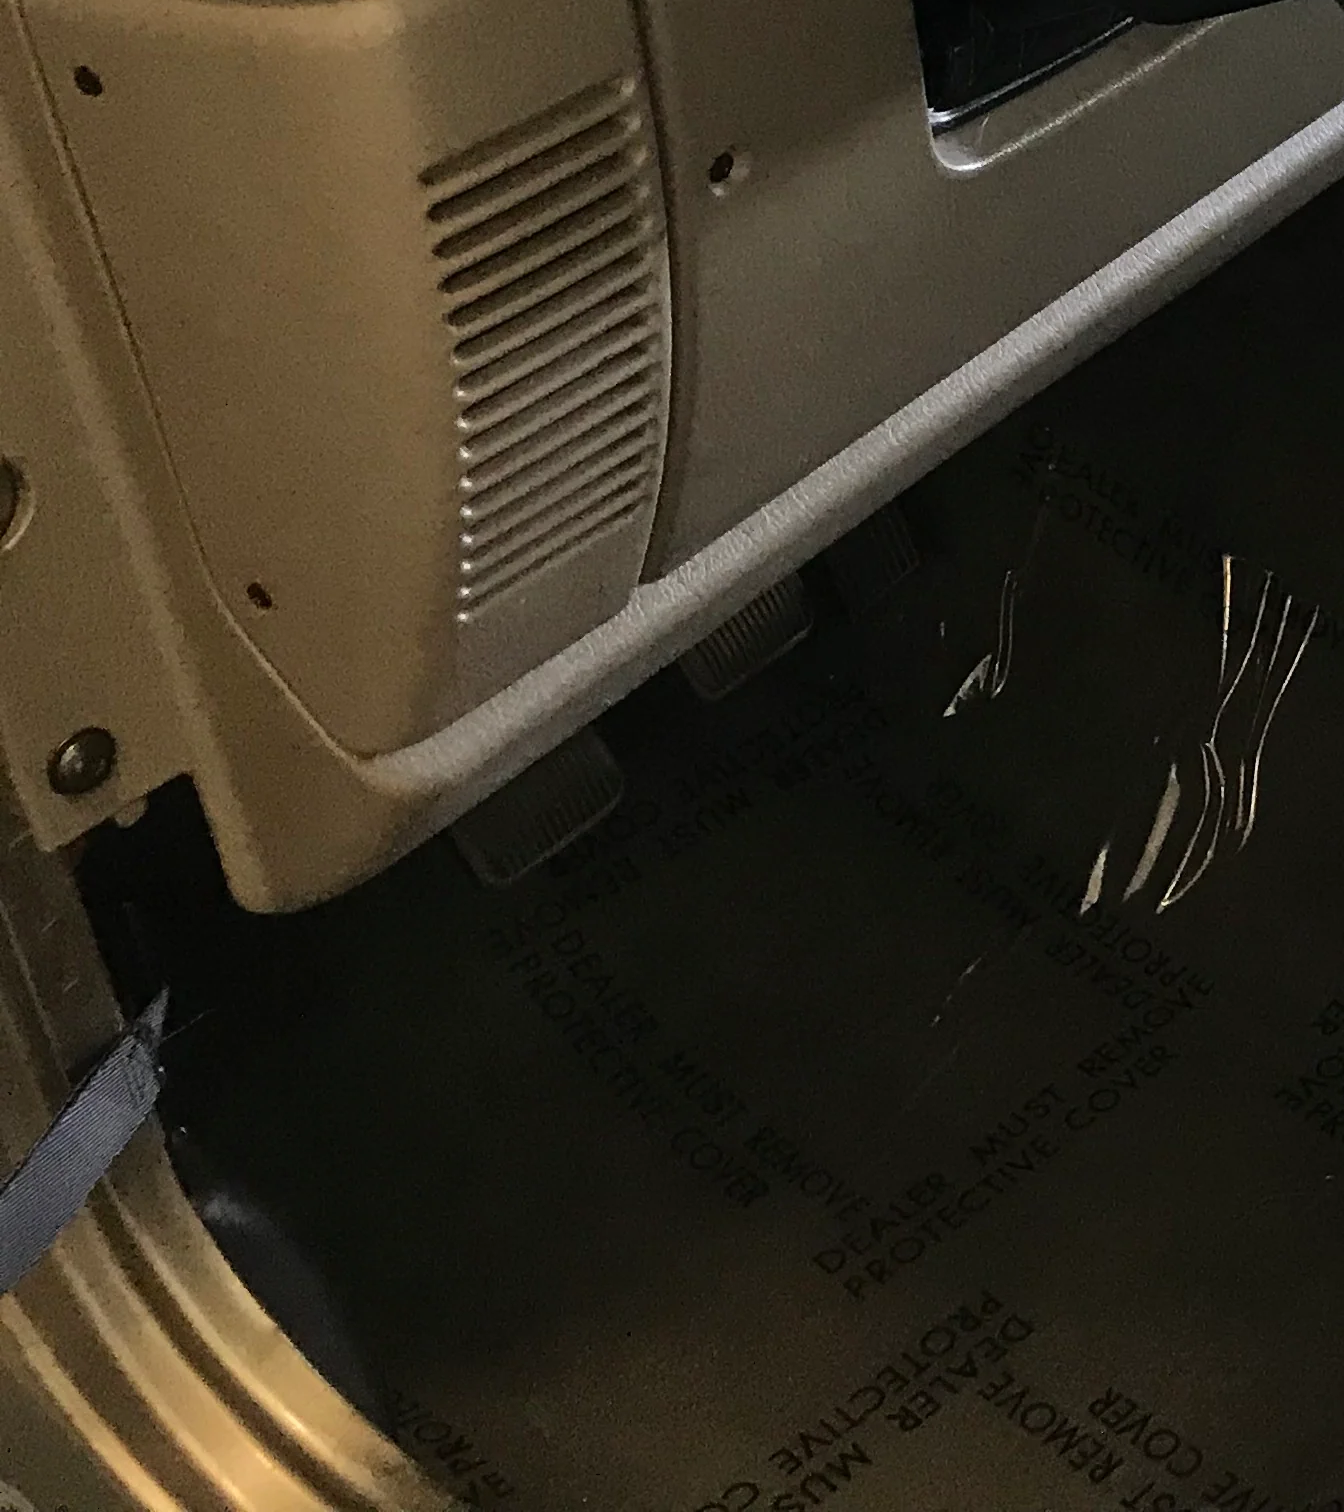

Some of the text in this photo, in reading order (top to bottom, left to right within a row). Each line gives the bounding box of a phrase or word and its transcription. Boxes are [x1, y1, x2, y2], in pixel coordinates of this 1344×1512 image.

[811, 973, 1216, 1276] DEALER MUST REMOVE
[842, 1132, 1062, 1301] PROTECTIVE
[1064, 1043, 1181, 1132] COVER
[767, 1289, 1004, 1476] PROTECTIVE
[886, 1313, 1036, 1433] DEALER
[977, 1372, 1125, 1485] REMOVE
[1087, 1386, 1203, 1479] COVER
